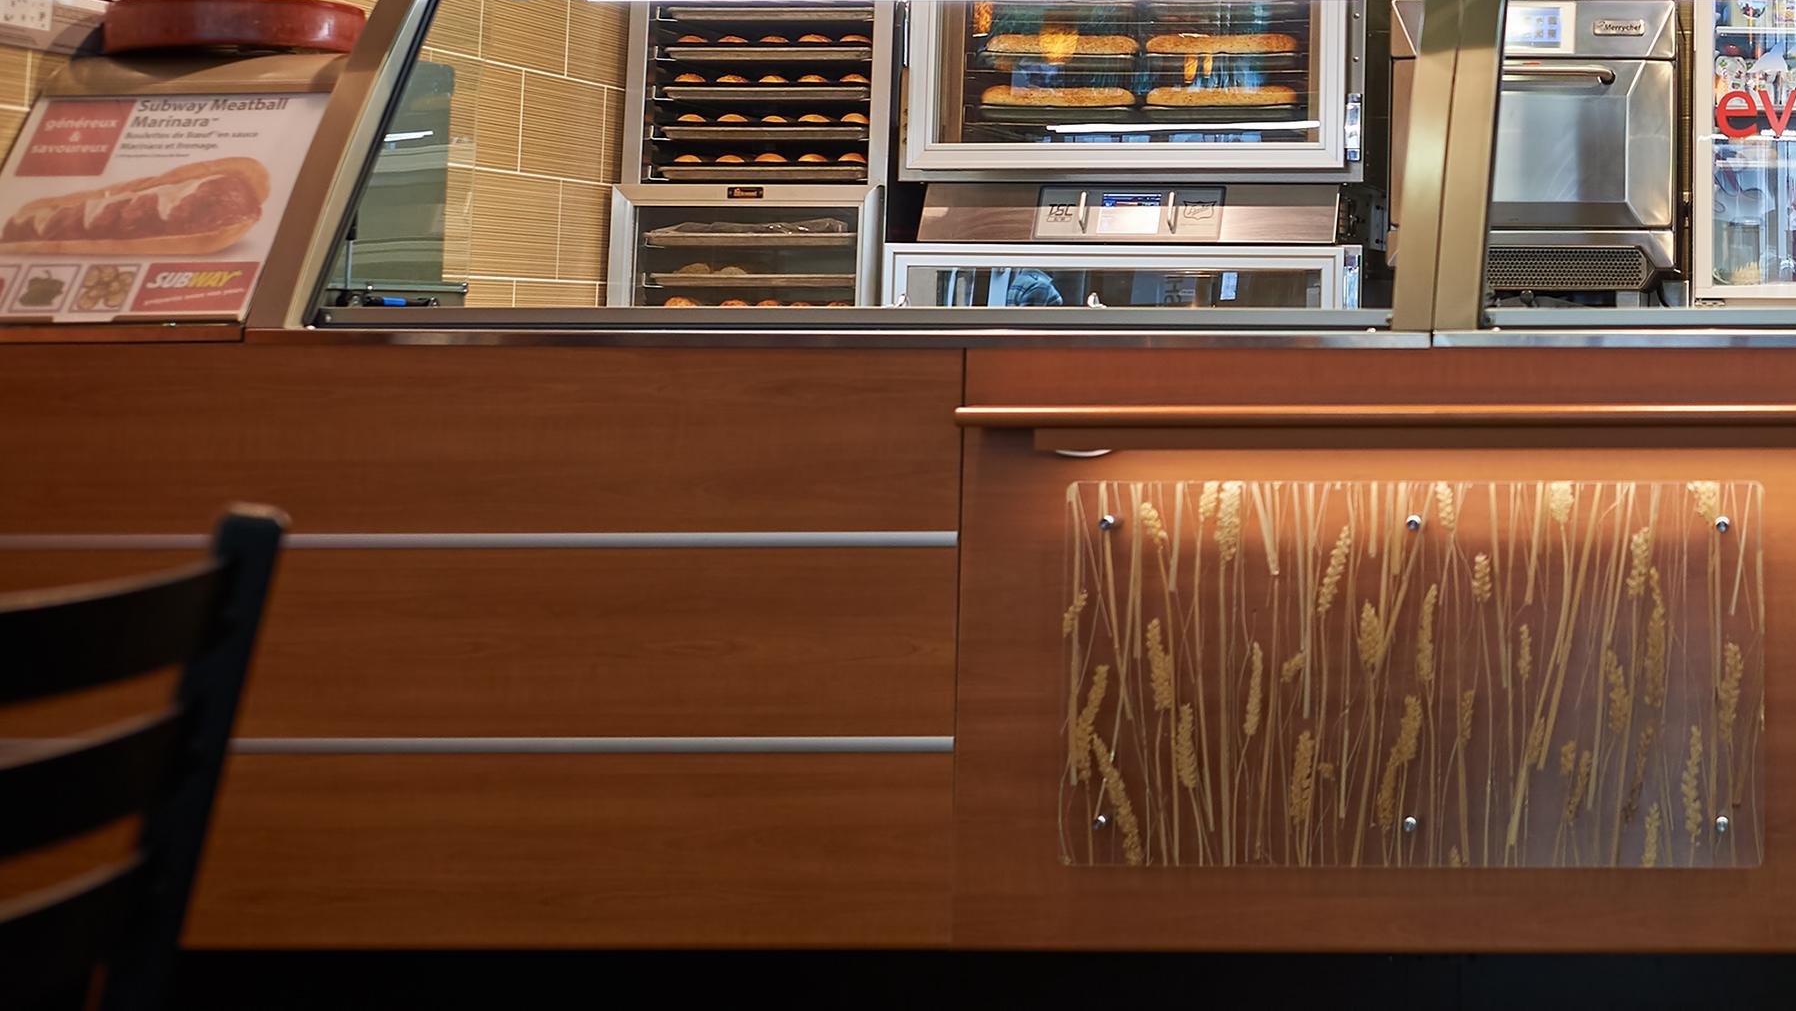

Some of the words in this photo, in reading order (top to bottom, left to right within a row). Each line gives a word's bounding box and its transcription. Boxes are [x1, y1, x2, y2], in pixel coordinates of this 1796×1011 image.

[1603, 23, 1642, 32] Merrychef
[137, 98, 207, 113] Subway
[210, 97, 290, 111] Meatball
[45, 117, 118, 130] généreux
[31, 144, 108, 154] savoureux
[148, 269, 235, 288] SUBWAY
